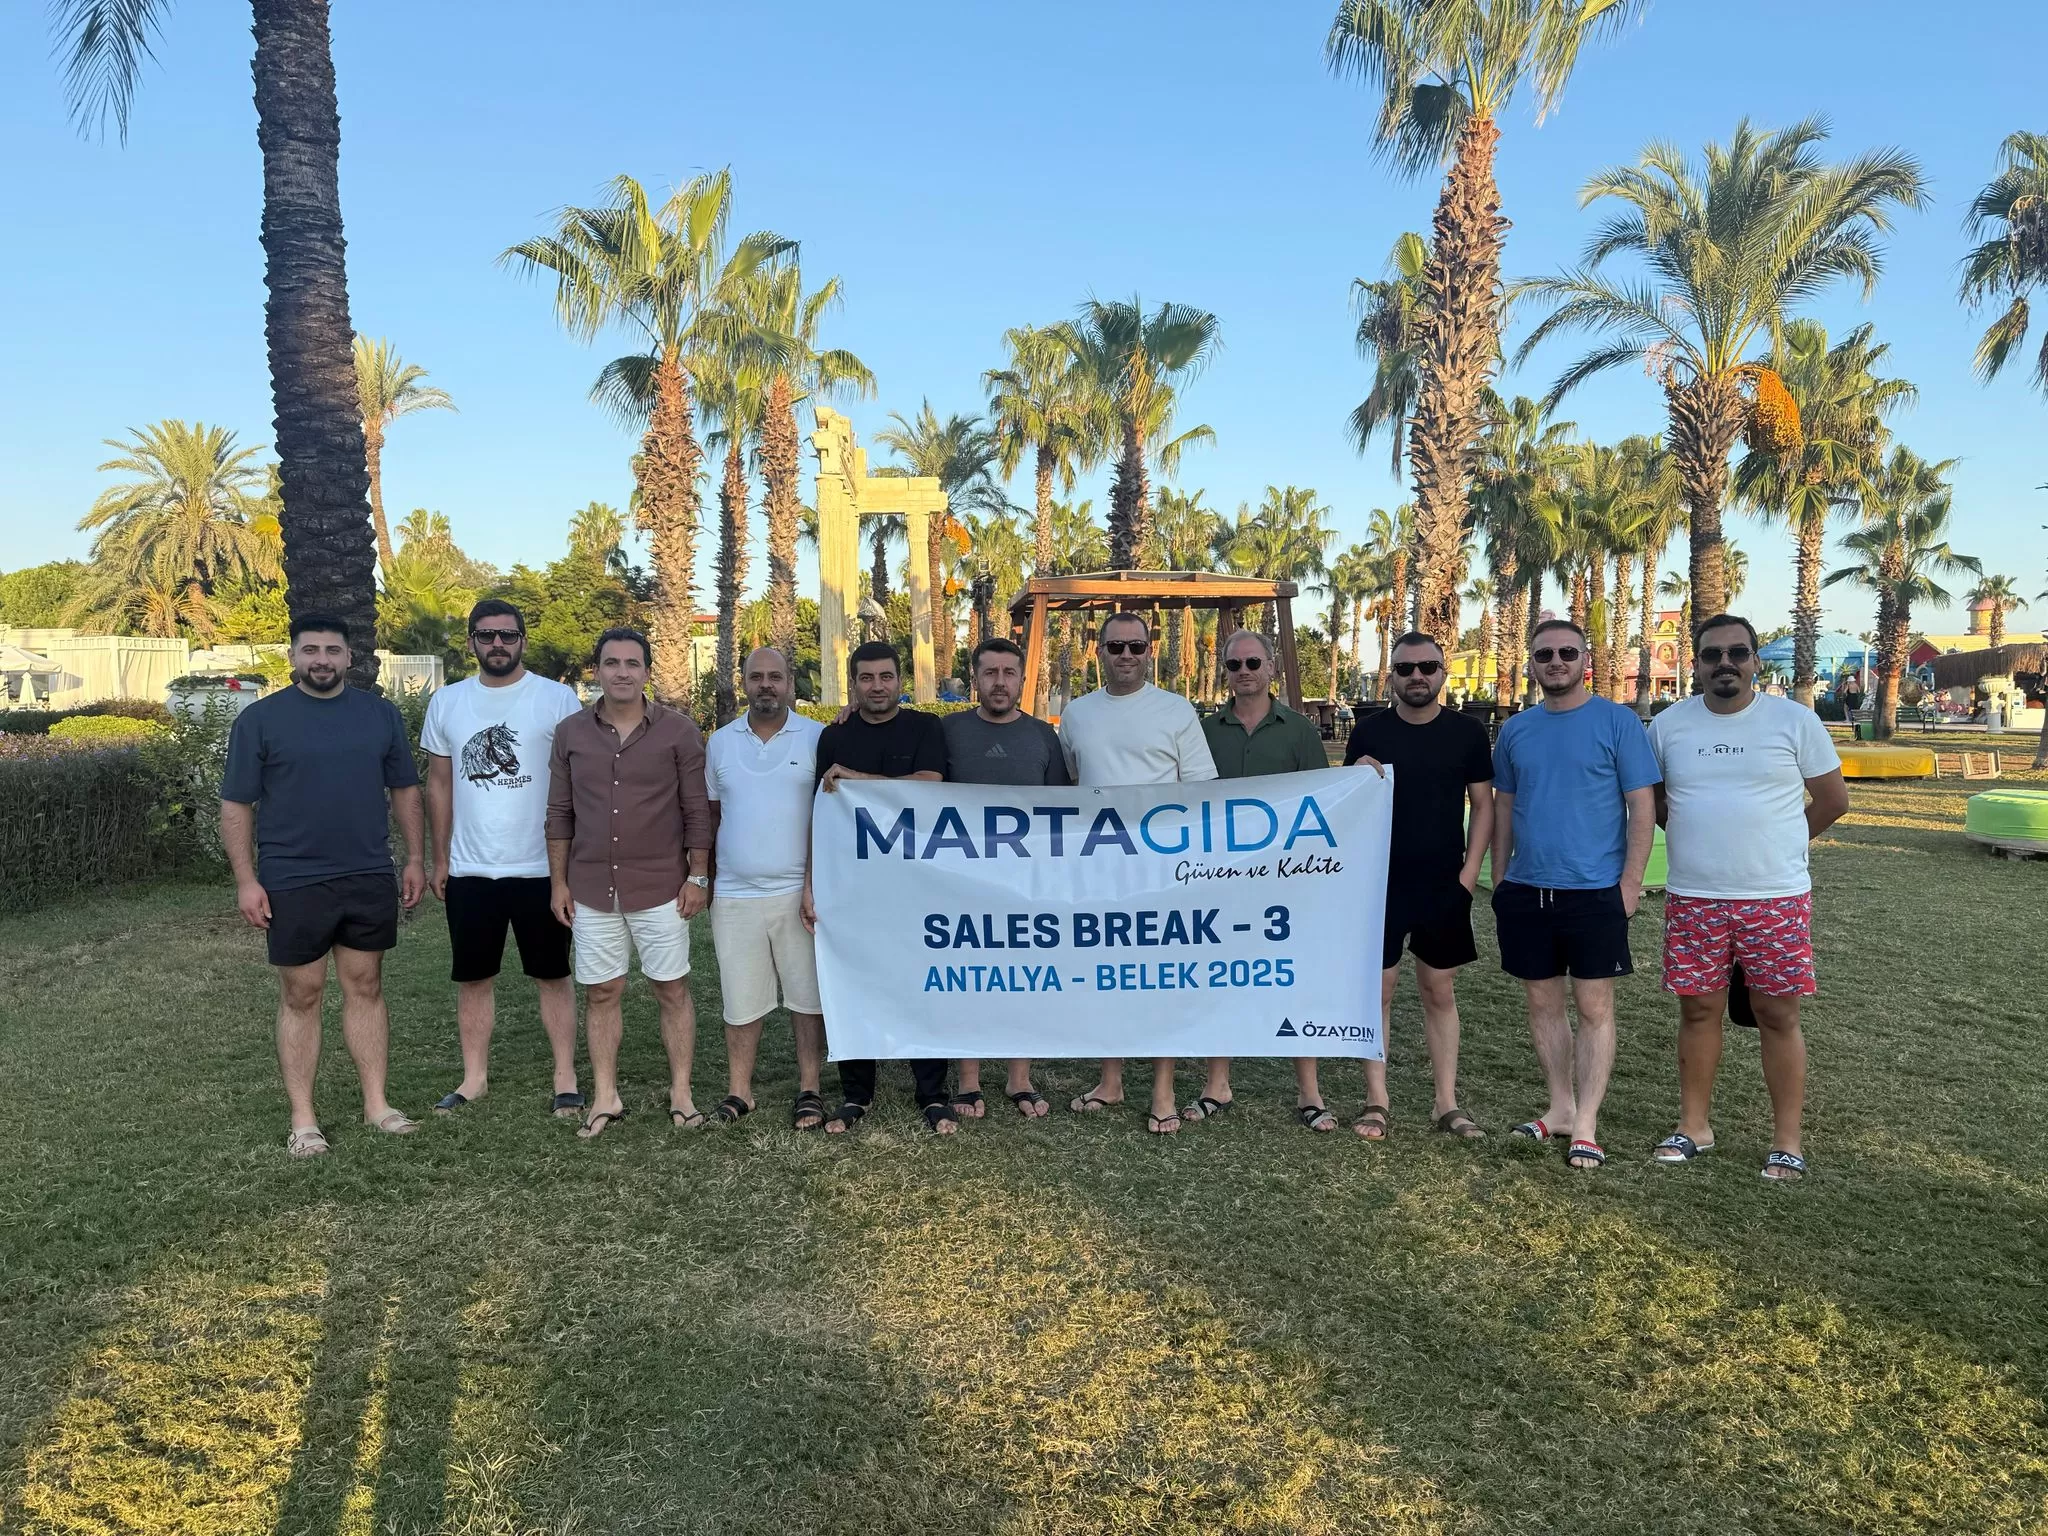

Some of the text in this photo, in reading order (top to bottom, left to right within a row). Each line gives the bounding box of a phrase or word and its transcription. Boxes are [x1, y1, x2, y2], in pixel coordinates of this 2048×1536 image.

[855, 796, 1338, 860] MARTAGIDA
[1174, 854, 1343, 885] Güven ve Kalite
[923, 905, 1291, 949] SALES BREAK - 3
[924, 966, 1062, 992] ANTALYA
[1096, 962, 1200, 991] BELEK
[1208, 959, 1295, 988] 2025
[1302, 1020, 1375, 1040] ÖZAYDIN
[1769, 1153, 1801, 1165] EA7
